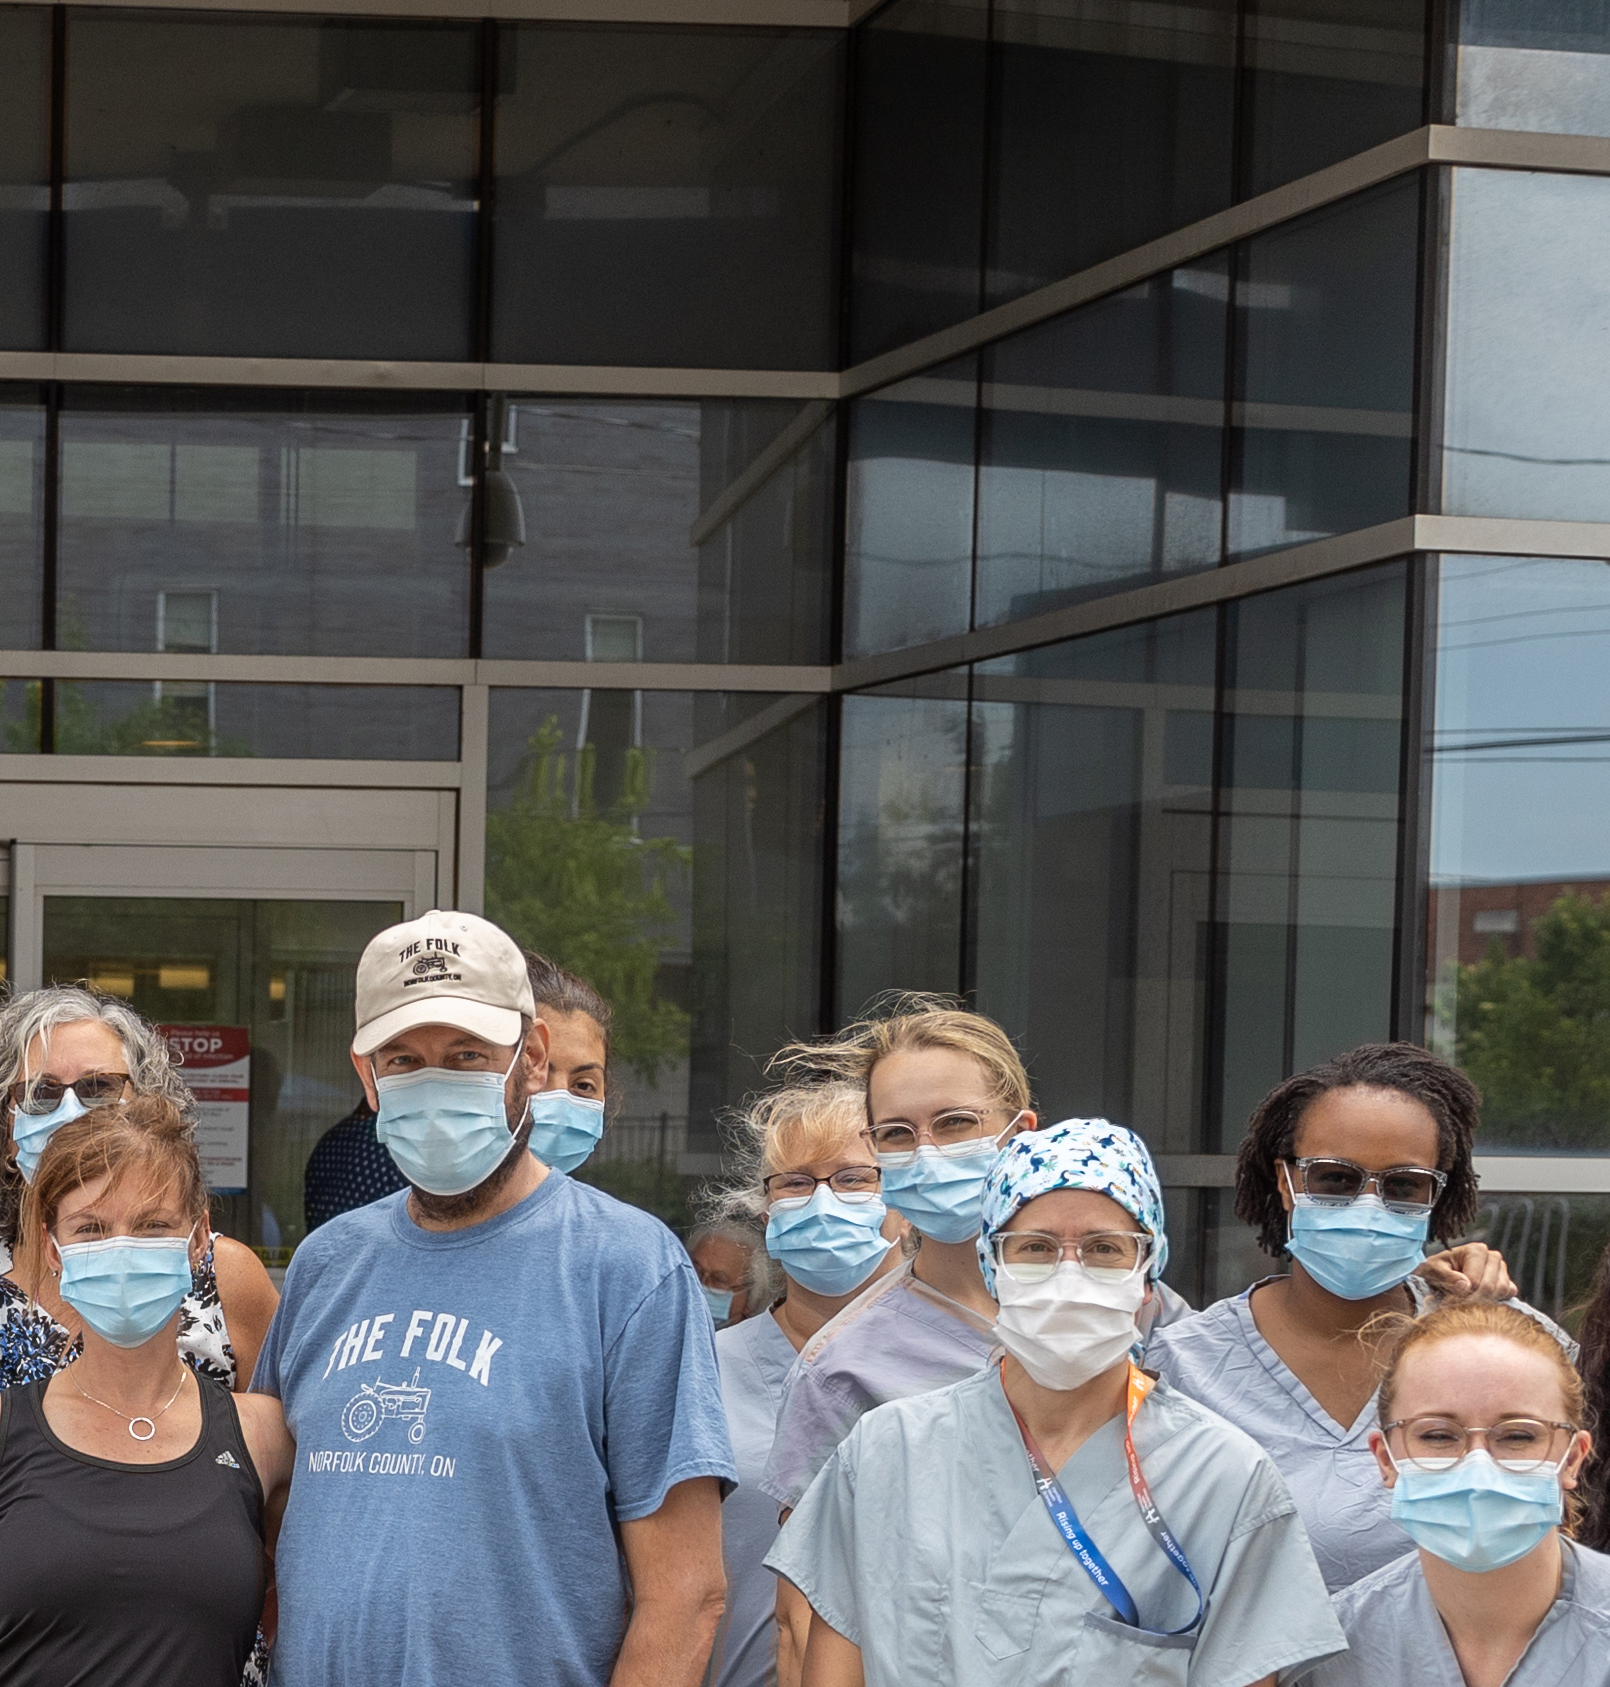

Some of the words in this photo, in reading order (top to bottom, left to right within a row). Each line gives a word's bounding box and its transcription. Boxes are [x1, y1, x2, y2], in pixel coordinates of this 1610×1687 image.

[399, 940, 421, 963] THE
[426, 938, 461, 957] FOLK
[169, 1037, 223, 1053] STOP
[322, 1313, 395, 1381] THE
[400, 1310, 503, 1387] FOLK
[308, 1450, 367, 1473] NORFOLK
[368, 1452, 427, 1475] COUNTY,
[430, 1455, 456, 1478] ON
[1056, 1511, 1076, 1540] Rising
[1071, 1538, 1083, 1552] up
[1082, 1549, 1109, 1587] together
